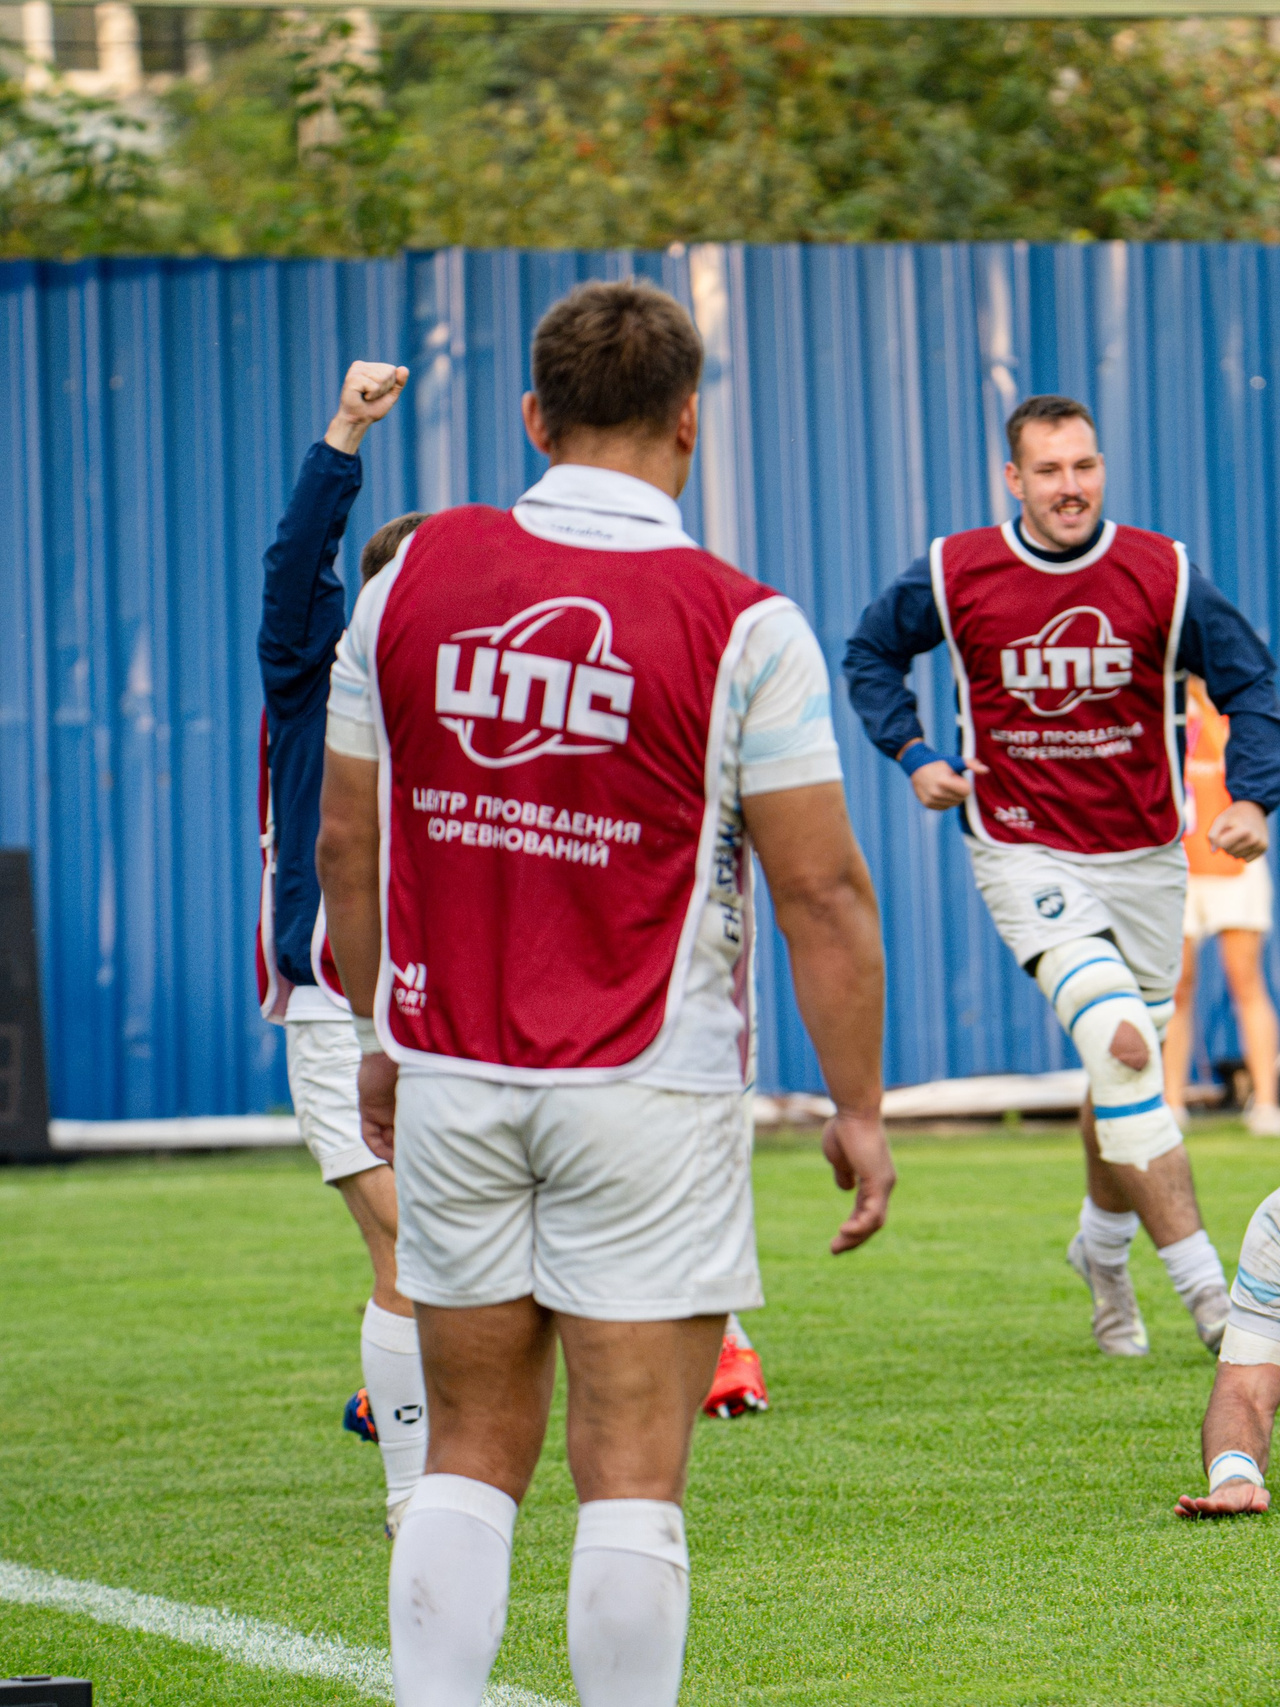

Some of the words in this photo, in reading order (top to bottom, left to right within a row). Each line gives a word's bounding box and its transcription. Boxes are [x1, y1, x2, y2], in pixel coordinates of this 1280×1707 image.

[436, 643, 635, 744] ЦПС
[1001, 647, 1133, 690] ЦПС
[474, 794, 642, 845] ПРОВЕДЕНИЯ
